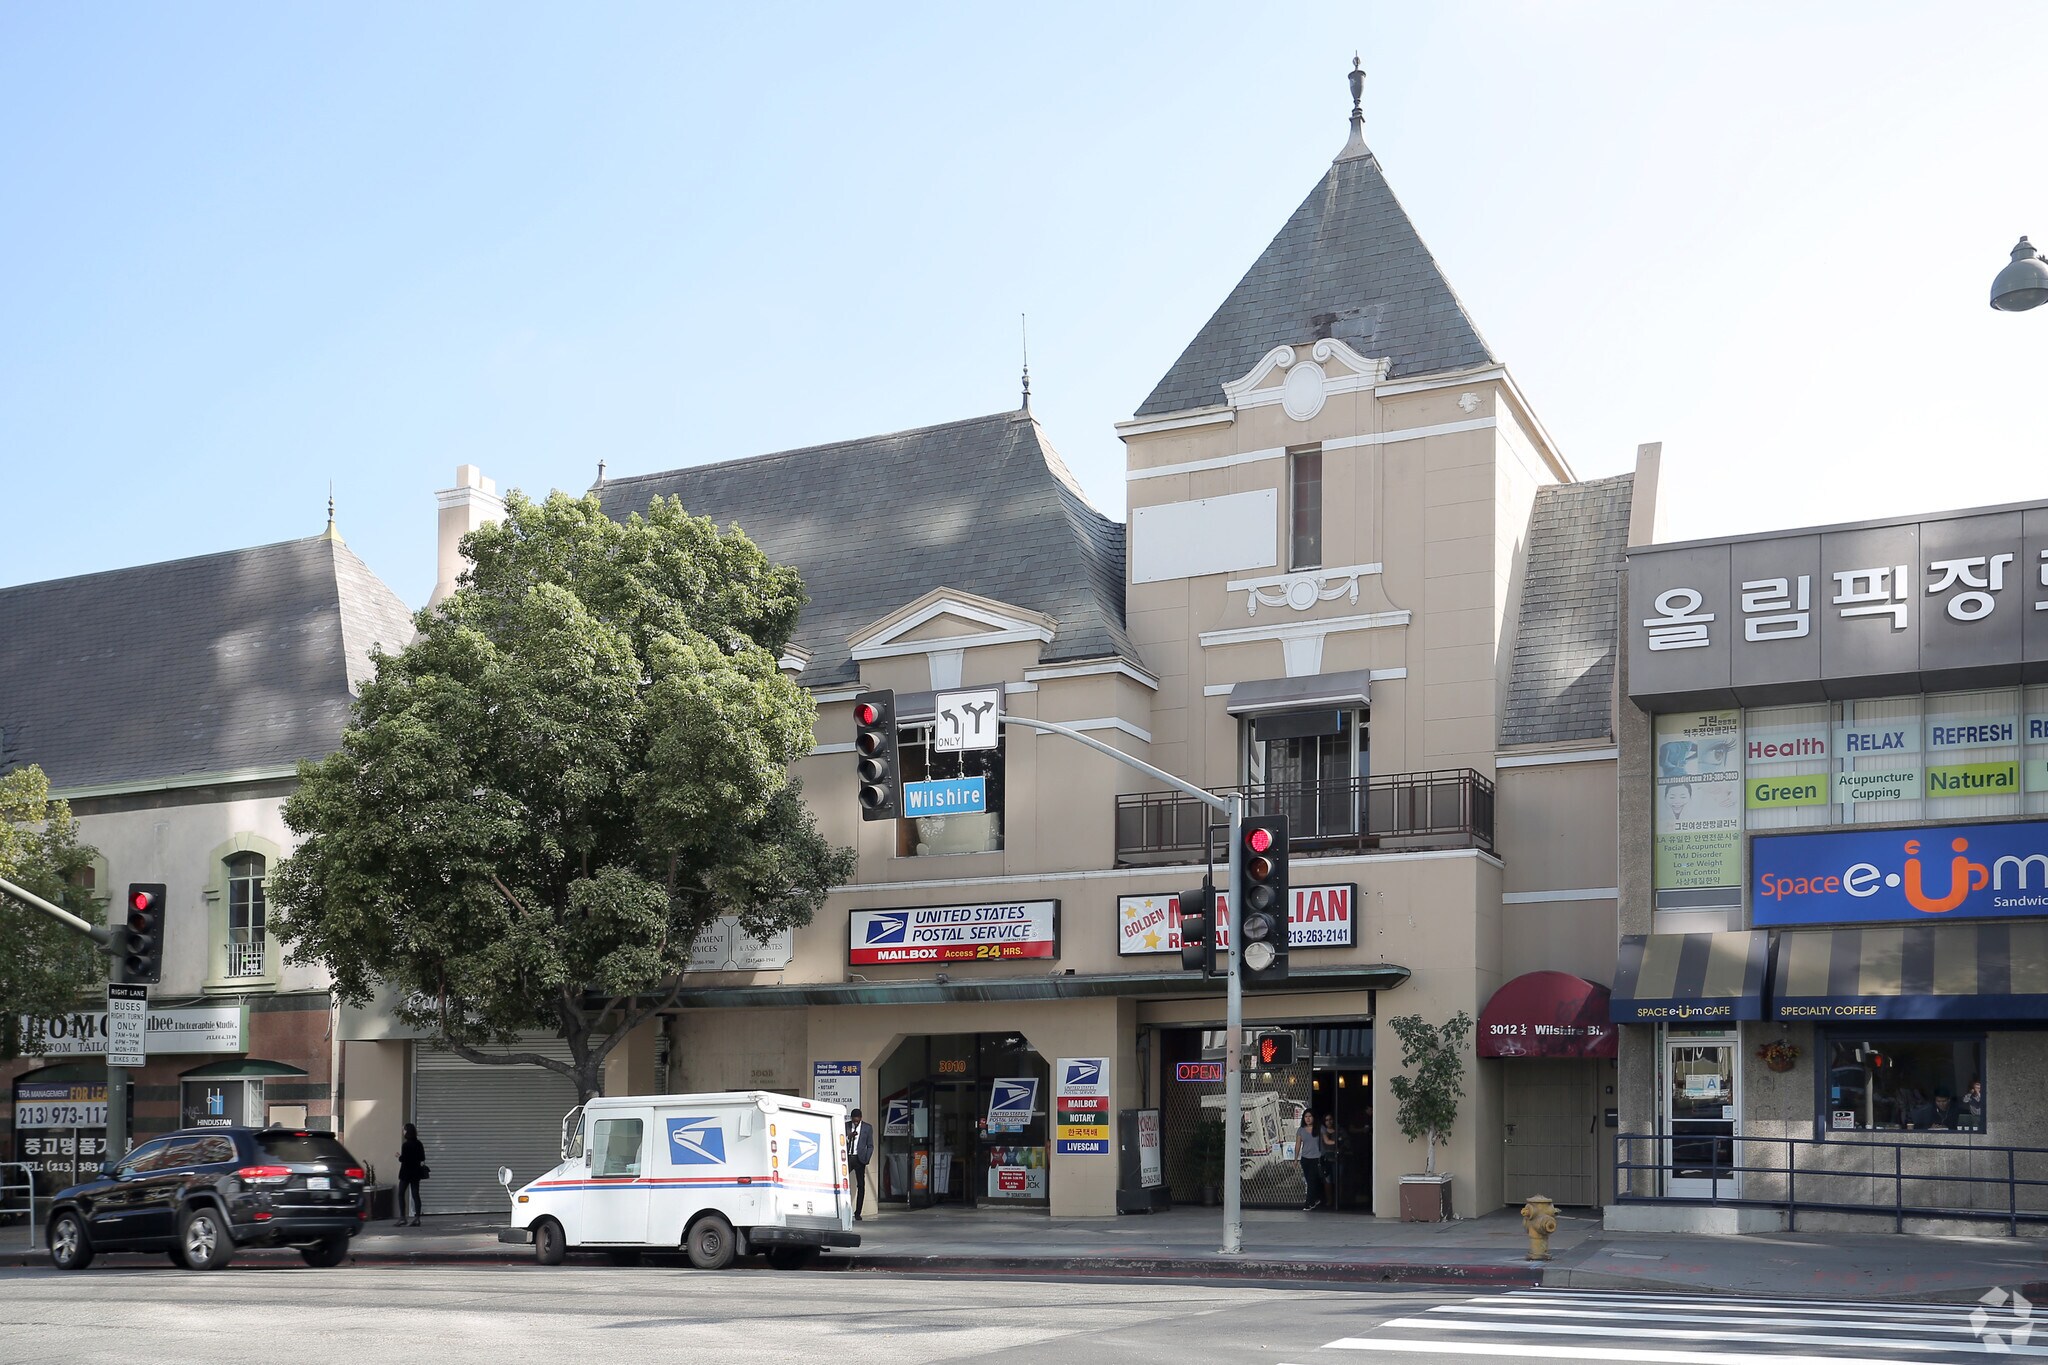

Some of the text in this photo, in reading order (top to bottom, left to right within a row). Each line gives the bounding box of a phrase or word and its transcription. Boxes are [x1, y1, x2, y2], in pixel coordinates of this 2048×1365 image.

[1642, 553, 2048, 652] 올림픽장
[1932, 724, 2013, 746] REFRESH
[938, 737, 961, 747] ONLY
[1846, 732, 1905, 752] RELAX
[1748, 738, 1825, 759] Health
[1839, 771, 1914, 786] Acupuncture
[1930, 767, 2014, 791] Natural
[909, 788, 981, 809] Wilshire
[1754, 784, 1817, 802] Green
[1851, 787, 1901, 800] Cupping
[1664, 842, 1733, 852] Facial Acupuncture
[1691, 851, 1722, 859] Disorder
[1696, 860, 1724, 868] Weight
[1693, 868, 1721, 876] Control
[1760, 873, 1840, 901] Space
[915, 906, 1026, 924] UNITED STATES
[1124, 908, 1166, 938] GOLDEN
[912, 924, 1032, 942] POSTAL SERVICE
[1288, 929, 1348, 943] 213-263-2141
[877, 944, 1024, 960] MAILBOX Access 24 HRS.
[110, 988, 145, 997] RIGHT LANE
[114, 1001, 141, 1011] BUSES
[1637, 1008, 1668, 1017] SPACE
[1704, 1006, 1731, 1016] CAFE
[1780, 1005, 1877, 1016] SPECIALTY COFFEE
[127, 1013, 144, 1021] TURNS
[117, 1021, 137, 1031] ONLY
[1489, 1024, 1518, 1035] 3012
[939, 1060, 967, 1073] 3010
[1178, 1064, 1221, 1080] OPEN
[1707, 1078, 1717, 1089] A
[18, 1089, 69, 1098] TRA MANAGEMENT
[70, 1086, 89, 1100] FOR
[1067, 1099, 1098, 1108] MAILBOX
[196, 1118, 232, 1126] HINDUSTAN
[1069, 1113, 1096, 1123] NOTARY
[1067, 1128, 1098, 1137] 한국택배
[1067, 1142, 1099, 1151] LIVESCAN
